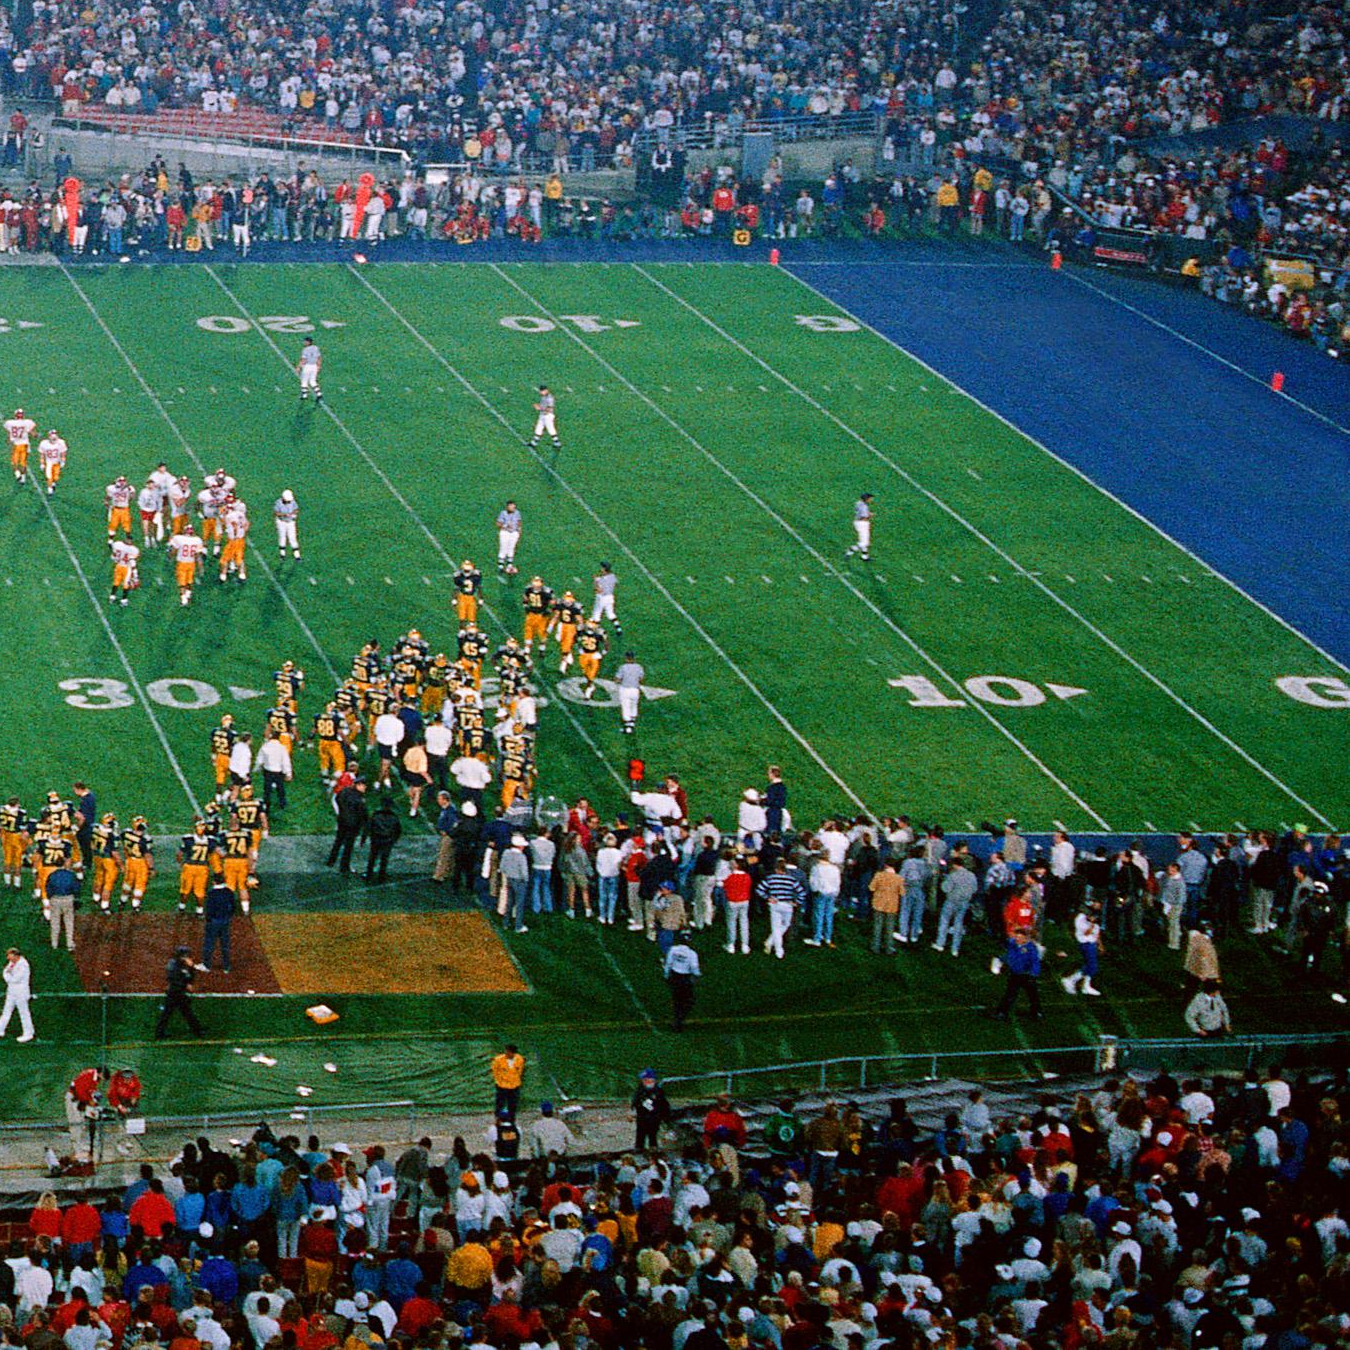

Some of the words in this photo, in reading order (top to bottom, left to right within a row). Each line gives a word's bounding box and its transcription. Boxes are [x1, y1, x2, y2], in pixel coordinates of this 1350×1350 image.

[197, 316, 318, 333] 20
[499, 315, 617, 333] 10
[796, 315, 861, 332] G
[11, 426, 25, 439] 87
[181, 544, 197, 558] 86
[529, 592, 542, 606] 91
[562, 608, 571, 622] 6
[58, 678, 222, 710] 30
[887, 675, 1047, 707] 10
[1275, 676, 1350, 707] G
[317, 719, 334, 737] 88
[238, 806, 257, 824] 97
[192, 845, 208, 861] 71
[227, 837, 246, 855] 74
